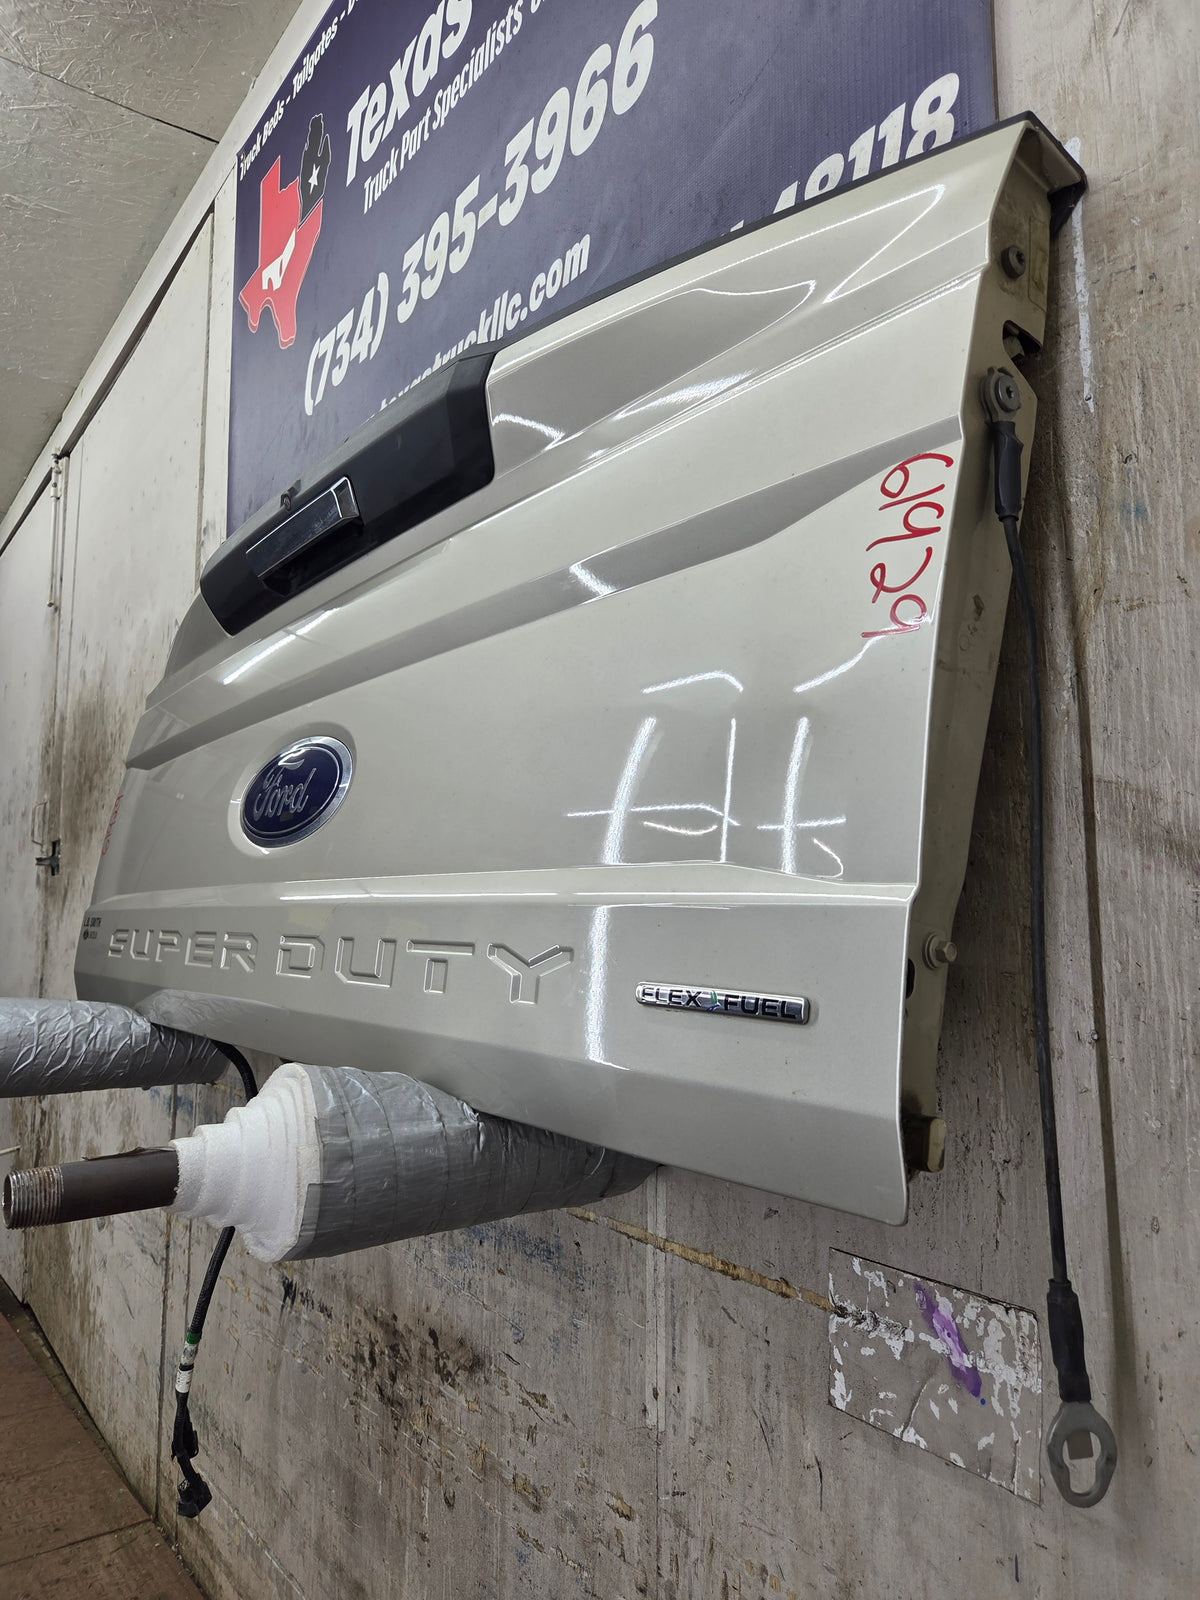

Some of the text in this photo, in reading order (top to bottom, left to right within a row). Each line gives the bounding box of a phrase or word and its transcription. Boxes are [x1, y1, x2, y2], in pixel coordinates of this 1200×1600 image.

[262, 99, 285, 147] Beds
[292, 16, 339, 100] Tailgates
[346, 0, 473, 188] Texas
[364, 0, 524, 215] Truck Part Specialists
[772, 72, 960, 214] 8118
[304, 0, 659, 416] (734) 395-3966
[252, 749, 317, 822] Ford
[107, 928, 575, 1004] SUPER DUTY
[641, 986, 797, 1020] FLEX FUEL
